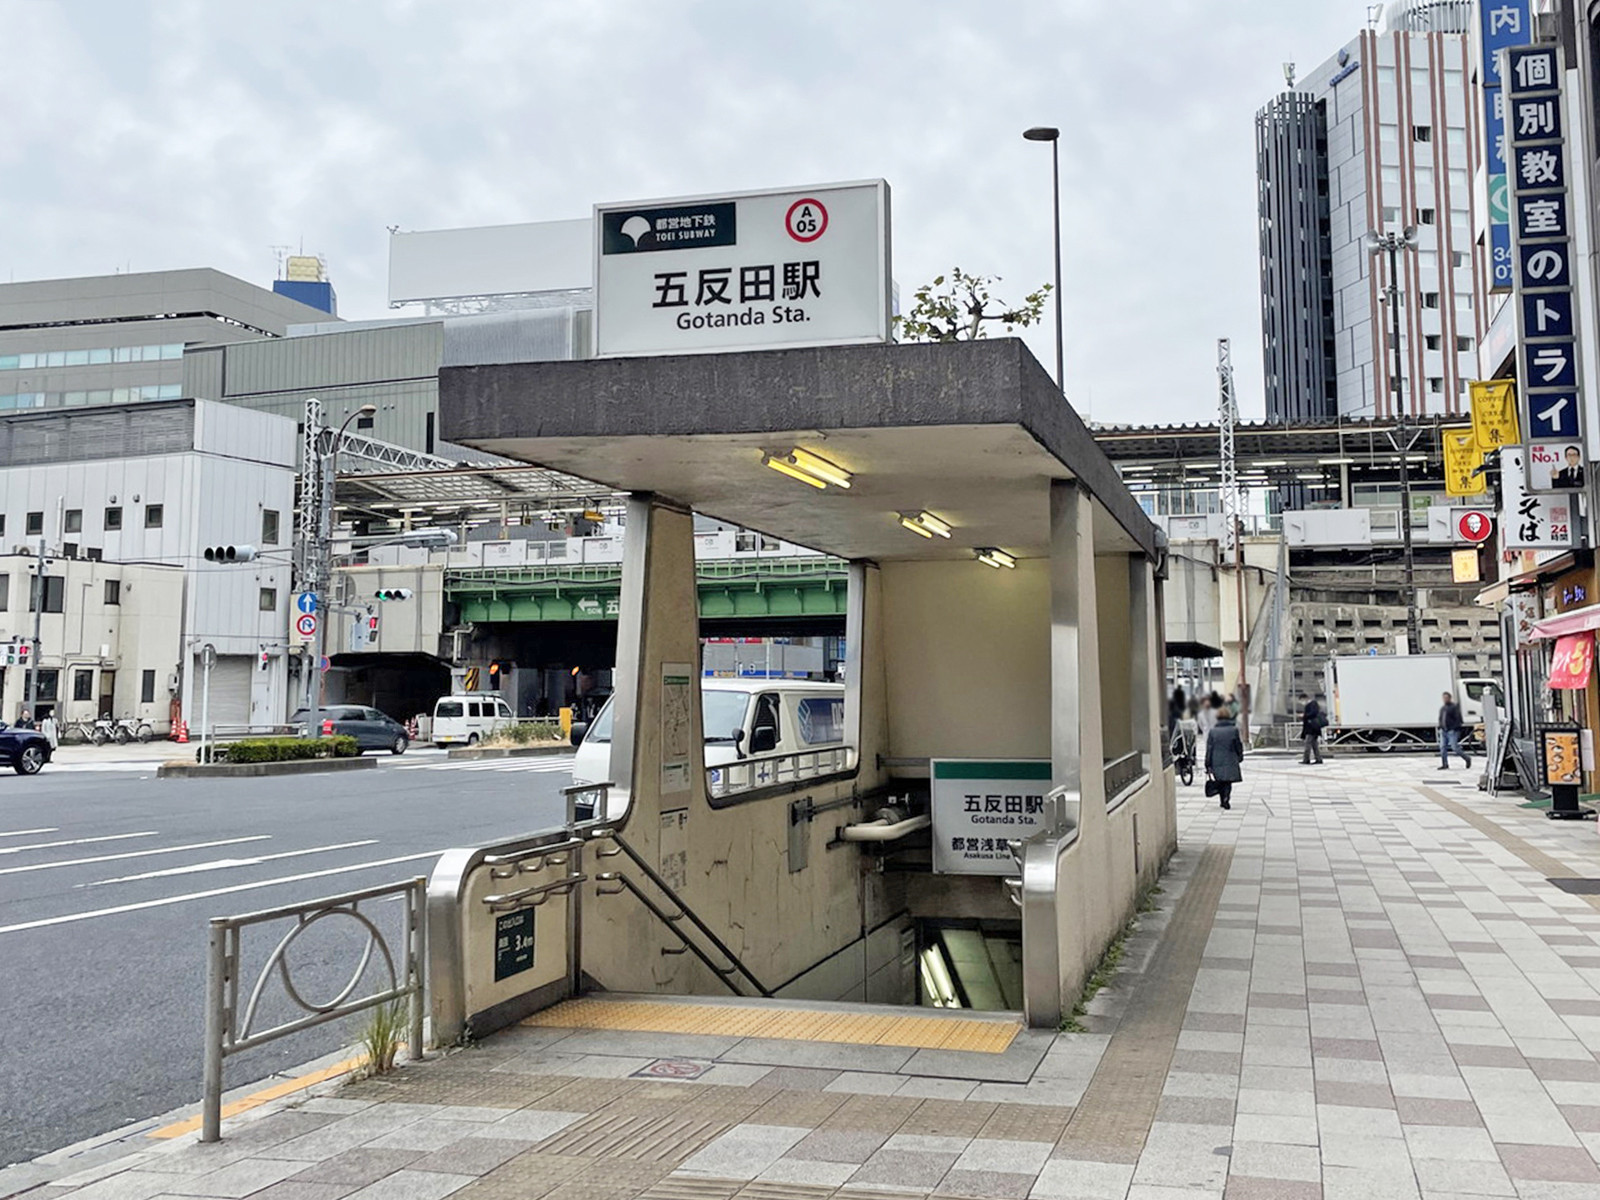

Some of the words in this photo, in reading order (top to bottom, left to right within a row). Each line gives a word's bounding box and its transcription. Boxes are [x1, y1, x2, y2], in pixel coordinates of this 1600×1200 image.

[801, 206, 812, 218] A
[655, 214, 716, 231] 都営地下鉄
[796, 219, 817, 233] 05
[655, 231, 676, 242] TOEI
[678, 228, 716, 240] SUBWAY
[1514, 53, 1568, 432] 個別教室のトライ
[652, 260, 821, 308] 五反田駅
[676, 307, 765, 330] Gotanda
[772, 305, 811, 324] Sta.
[1532, 452, 1560, 463] No.1
[1551, 524, 1568, 534] 24
[964, 795, 1044, 814] 五反田駅
[971, 814, 1015, 824] Gotanda
[1017, 815, 1037, 825] Sta.
[952, 837, 1021, 851] 都営浅草
